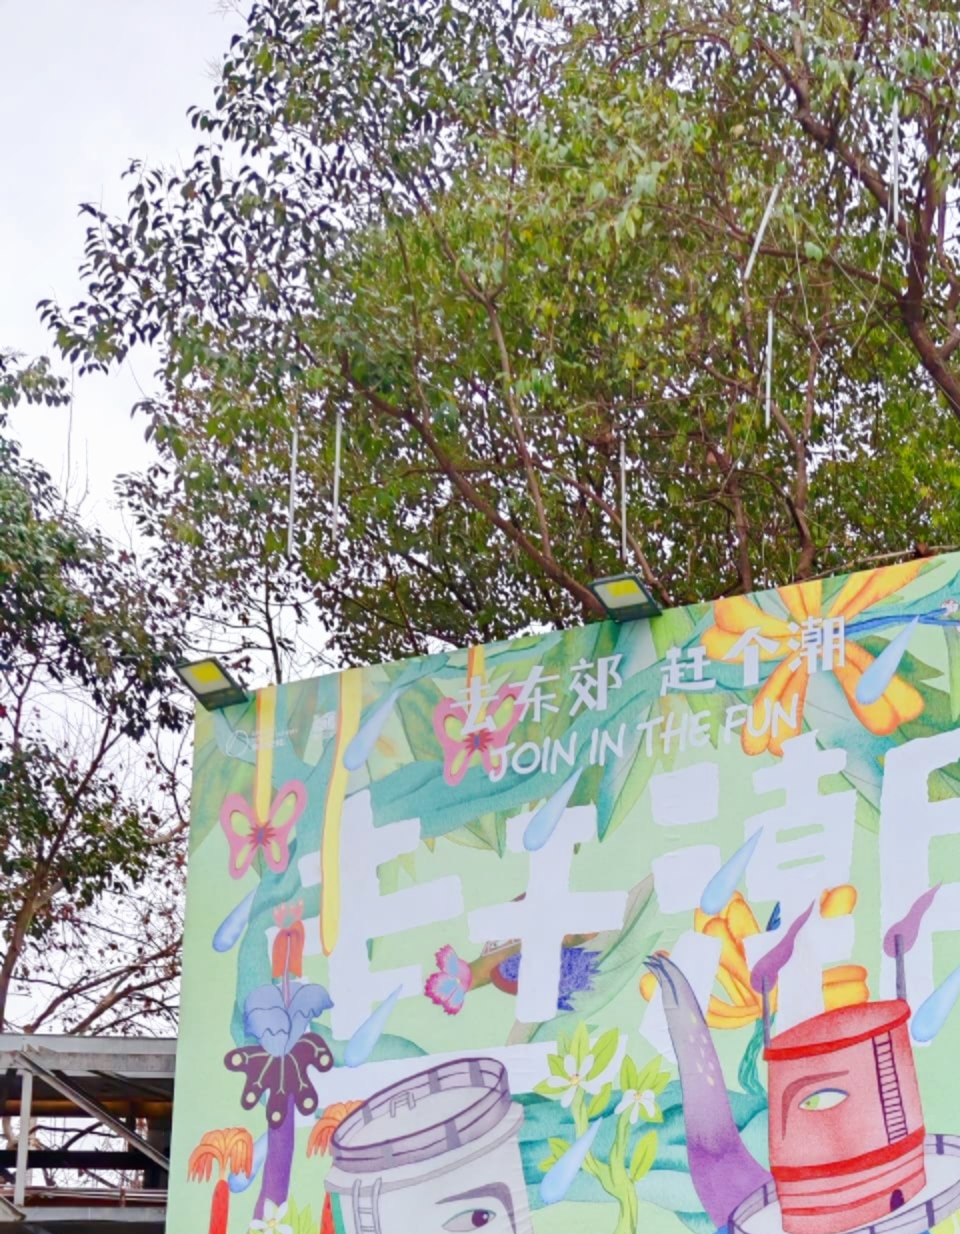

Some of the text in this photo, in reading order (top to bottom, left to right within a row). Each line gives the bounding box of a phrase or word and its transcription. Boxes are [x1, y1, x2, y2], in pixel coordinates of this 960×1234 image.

[450, 615, 846, 735] 去东郊 赶个潮
[488, 692, 799, 783] JOIN IN THE FUN
